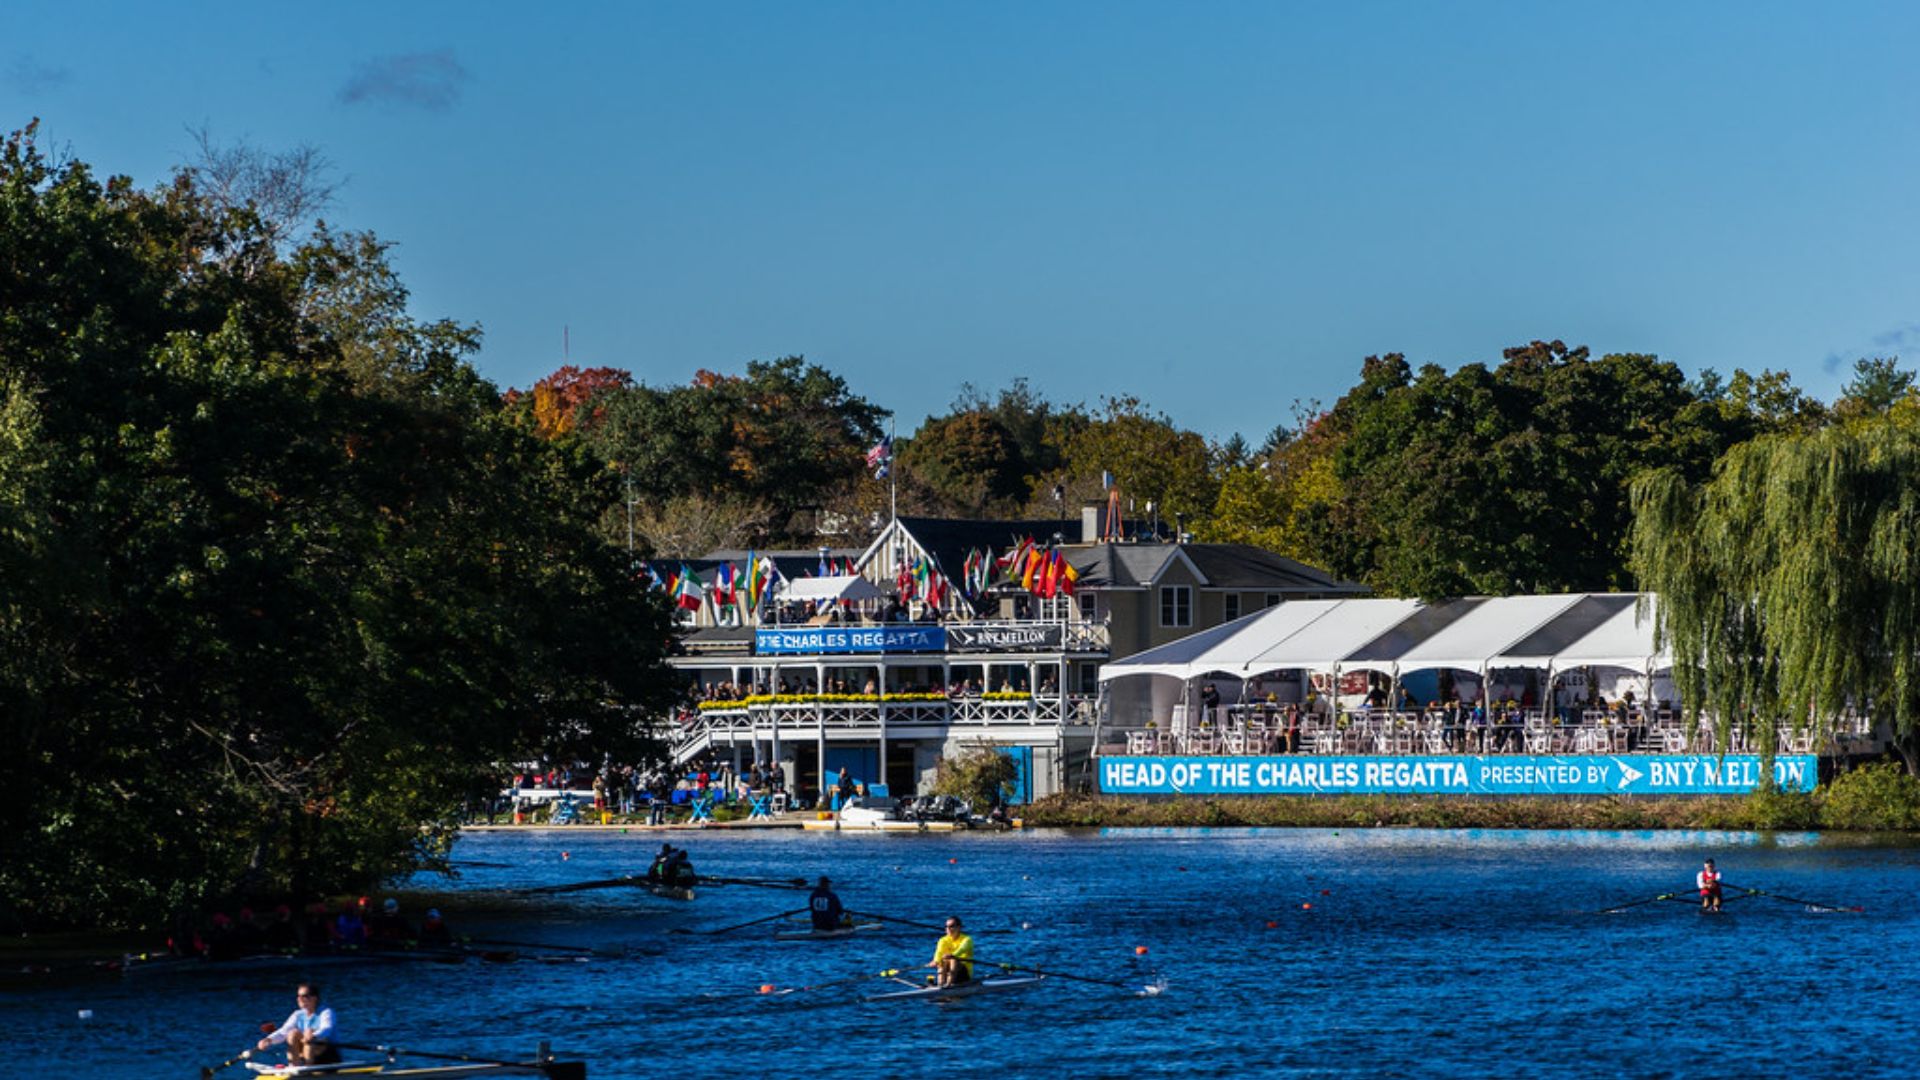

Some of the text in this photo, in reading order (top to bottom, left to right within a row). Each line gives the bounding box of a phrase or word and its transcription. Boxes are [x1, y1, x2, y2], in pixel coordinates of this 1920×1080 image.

[783, 634, 847, 648] CHARLES
[852, 632, 929, 646] REGATTA
[1000, 630, 1046, 643] MELLON
[1106, 763, 1166, 787] HEAD
[1171, 763, 1202, 787] OF
[1207, 763, 1250, 787] THE
[1256, 763, 1359, 787] CHARLES
[1365, 763, 1469, 787] REGATTA
[1481, 766, 1582, 784] PRESENTED
[1587, 766, 1610, 784] BY
[1649, 762, 1697, 786] BNY
